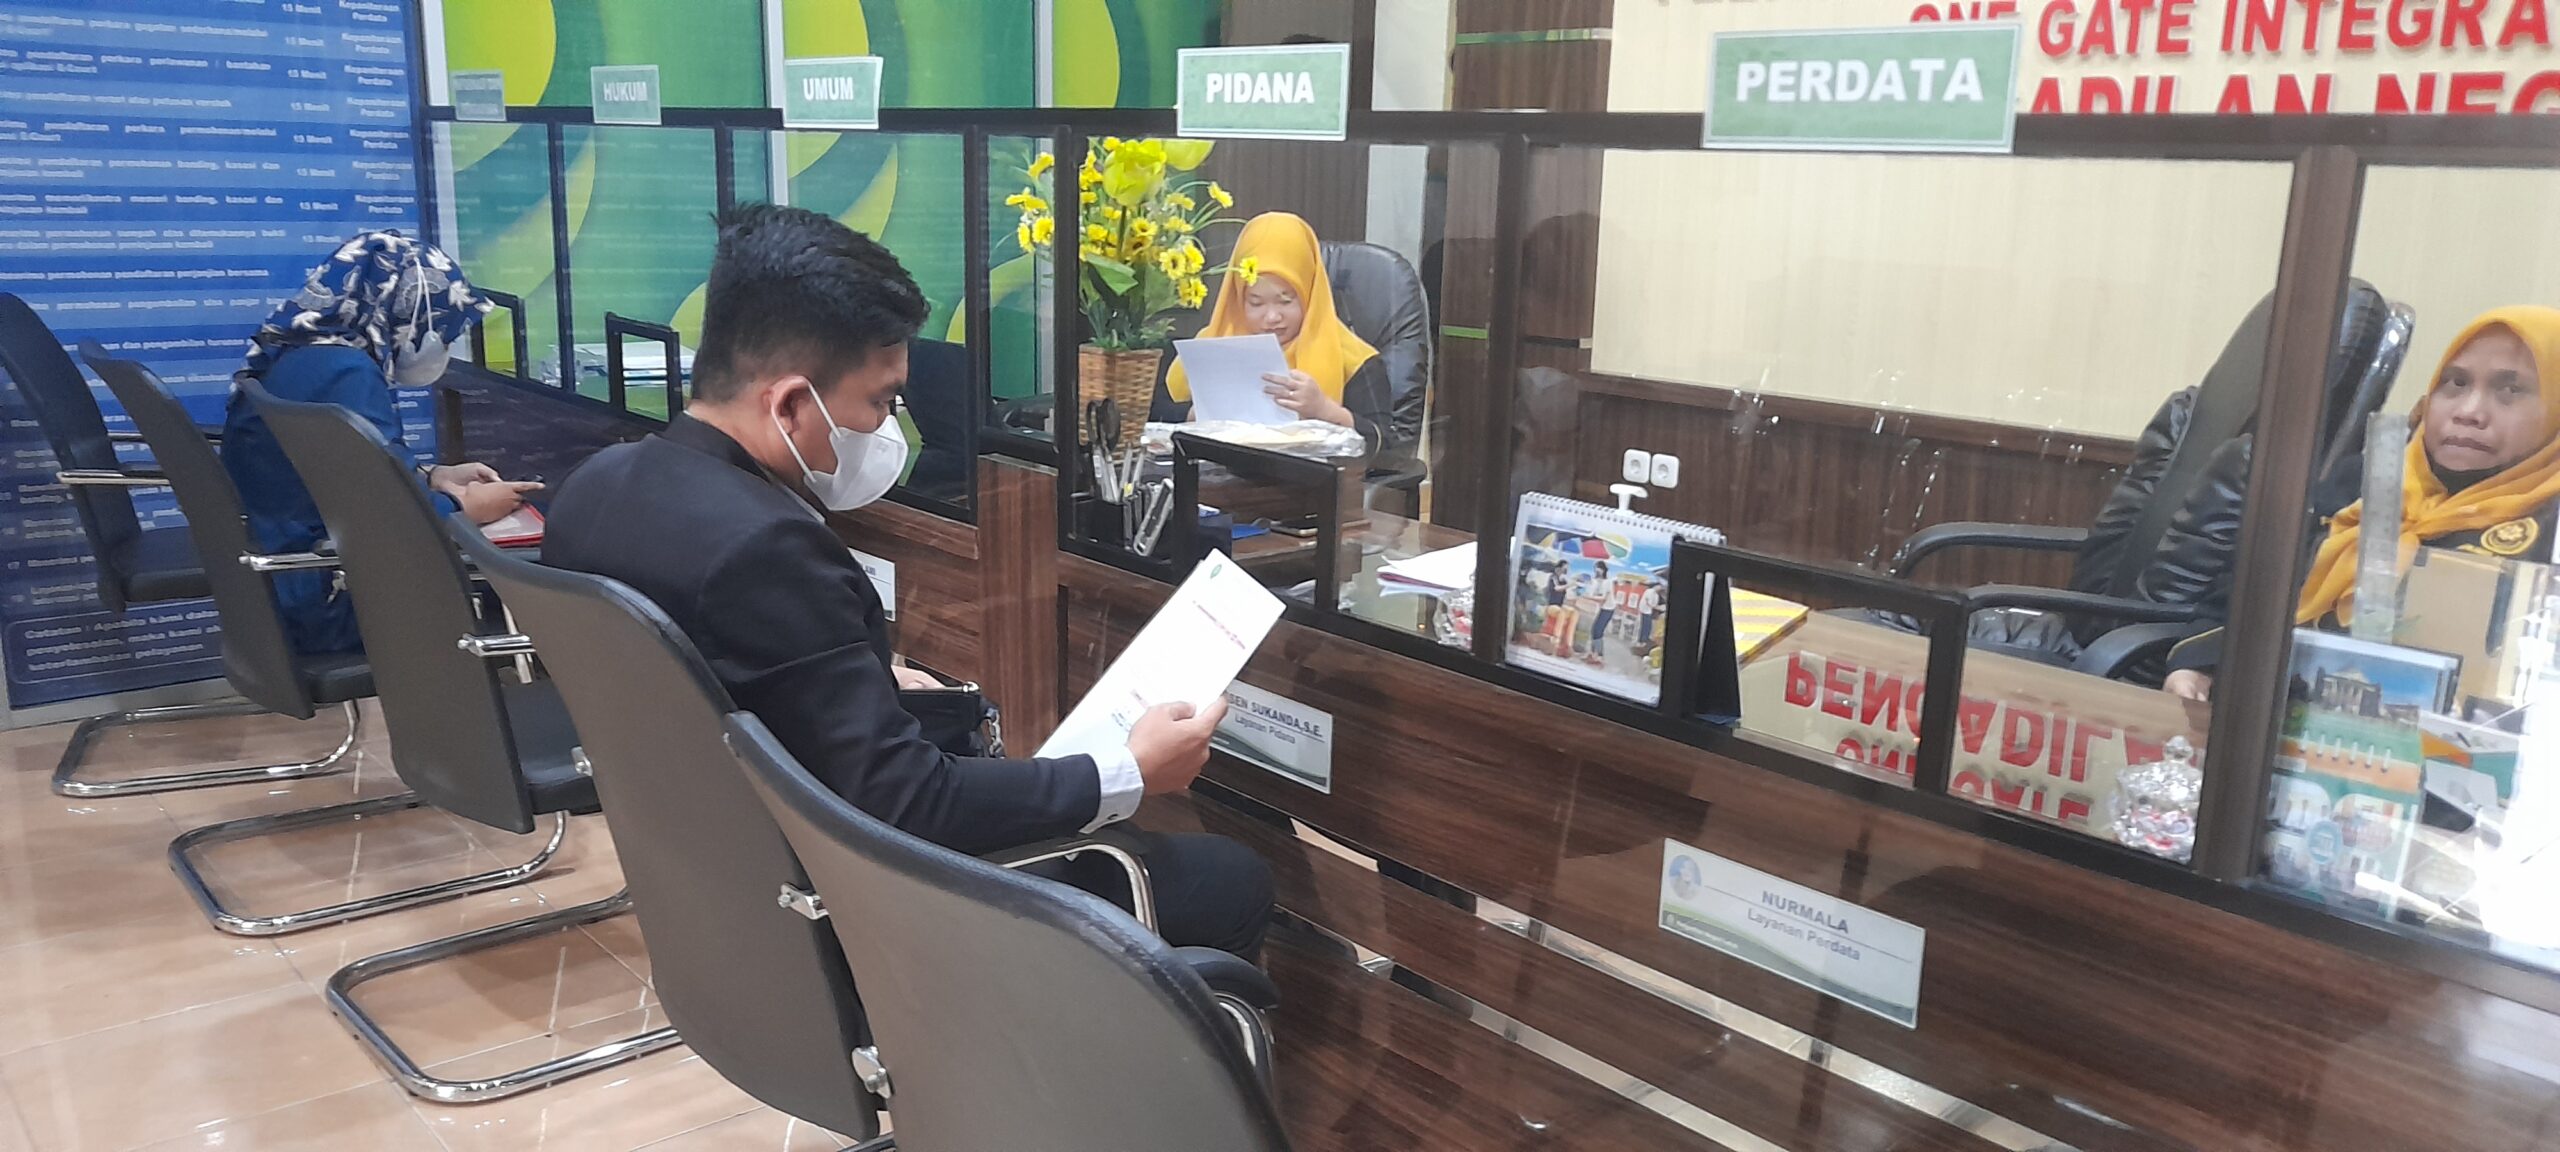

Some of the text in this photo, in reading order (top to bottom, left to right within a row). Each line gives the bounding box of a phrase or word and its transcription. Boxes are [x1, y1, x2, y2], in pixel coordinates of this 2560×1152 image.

[2038, 0, 2551, 57] GATE INTEGRA
[603, 81, 648, 101] HUKUM
[803, 76, 854, 101] UMUM
[1206, 71, 1315, 104] PIDANA
[1736, 57, 1984, 102] PERDATA
[1747, 907, 1803, 940] Layanan
[1807, 931, 1860, 961] Perdata
[1761, 890, 1849, 934] NURMALA
